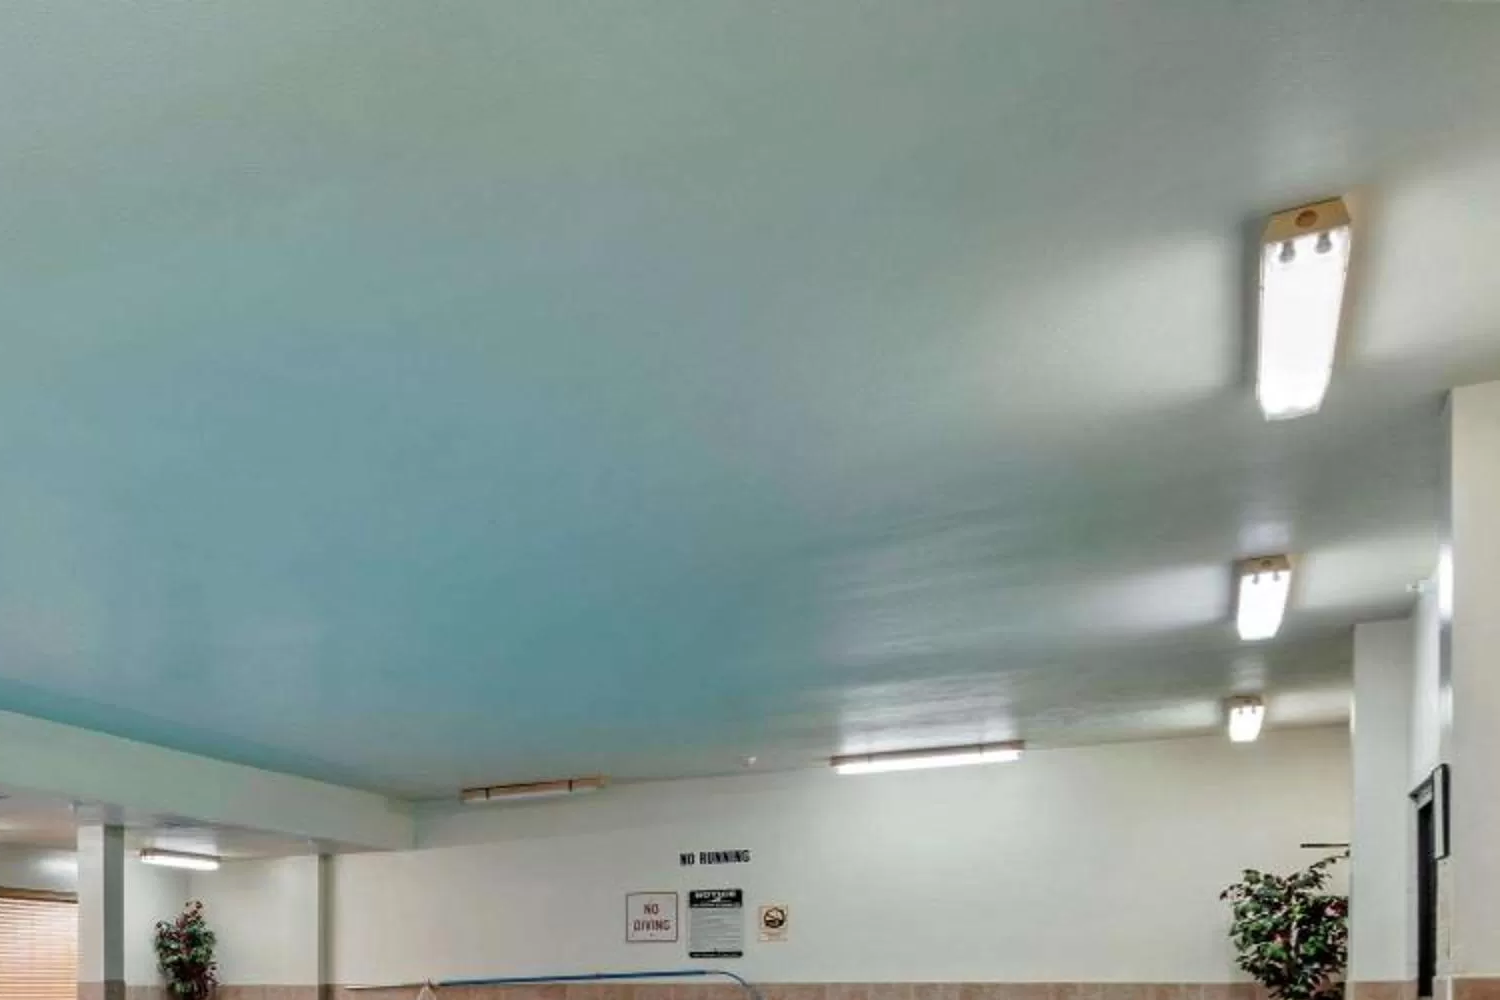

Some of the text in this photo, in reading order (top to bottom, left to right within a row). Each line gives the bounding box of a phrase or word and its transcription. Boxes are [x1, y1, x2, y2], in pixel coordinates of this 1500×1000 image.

[680, 850, 750, 865] NO RUNNING
[644, 903, 660, 915] NO
[633, 919, 671, 931] DIVING
